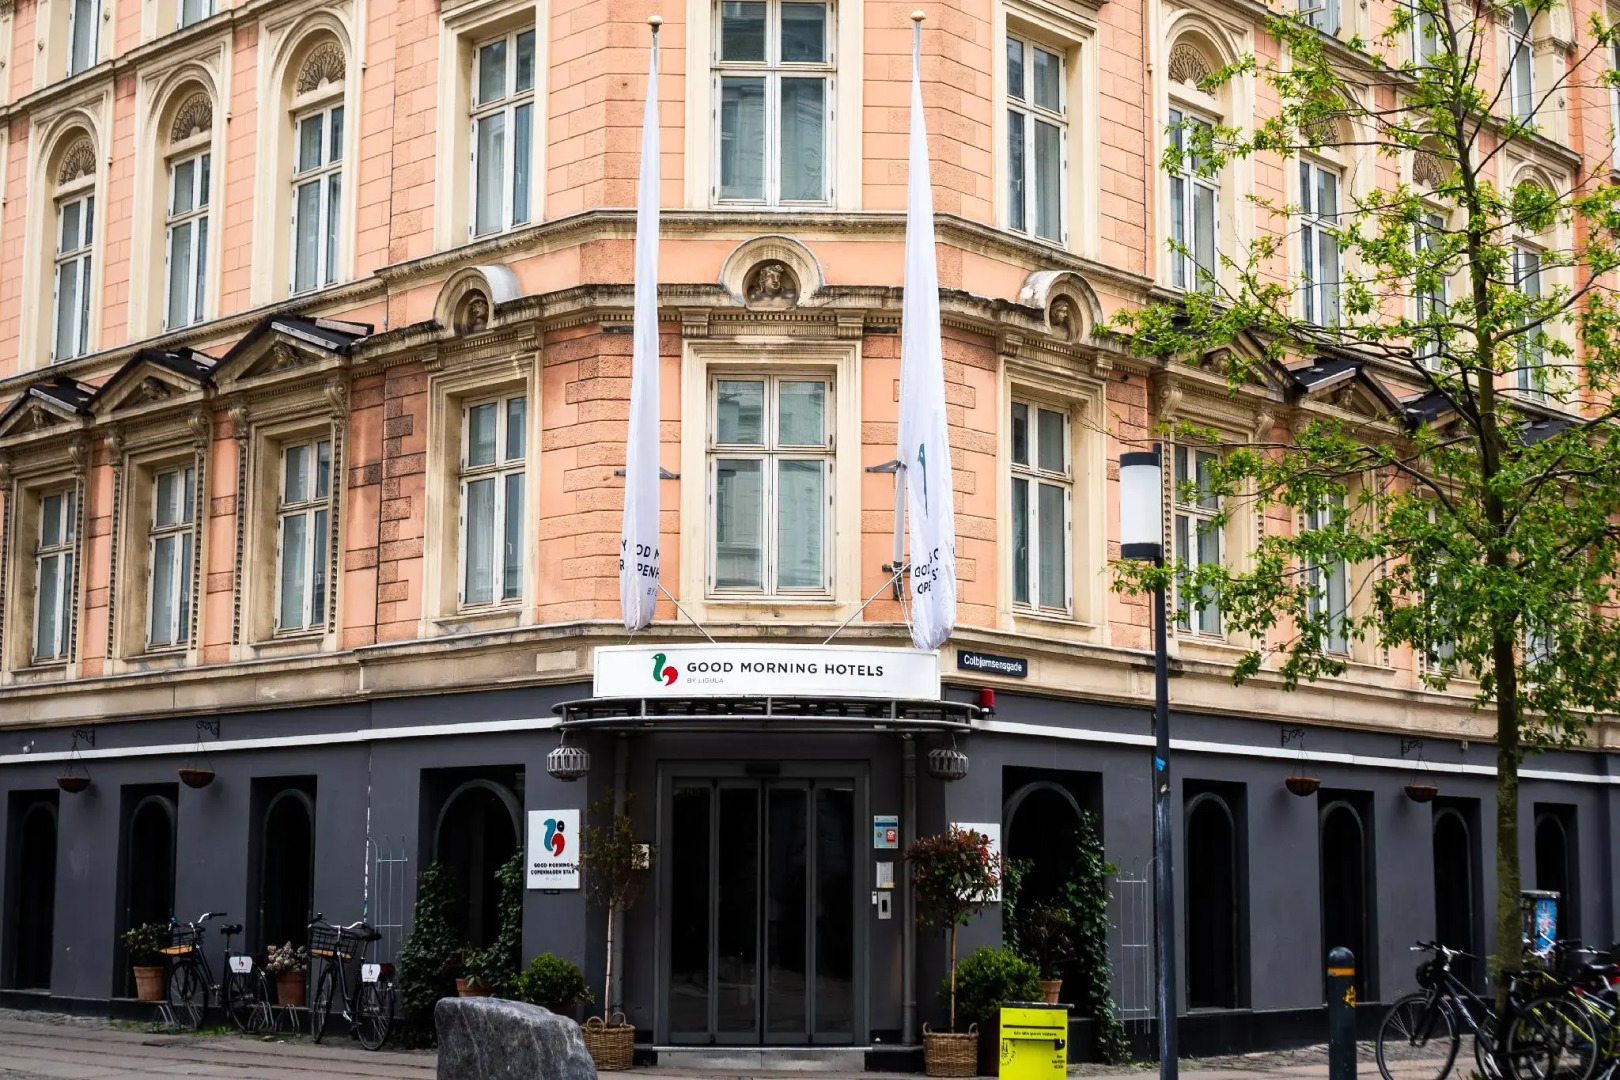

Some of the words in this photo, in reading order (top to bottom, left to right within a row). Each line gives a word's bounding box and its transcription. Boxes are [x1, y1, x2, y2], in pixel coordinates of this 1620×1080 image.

[686, 662, 734, 673] GOOD
[740, 662, 818, 674] MORNING
[824, 663, 884, 677] HOTELS
[963, 654, 1023, 672] Colbjørnsensgade
